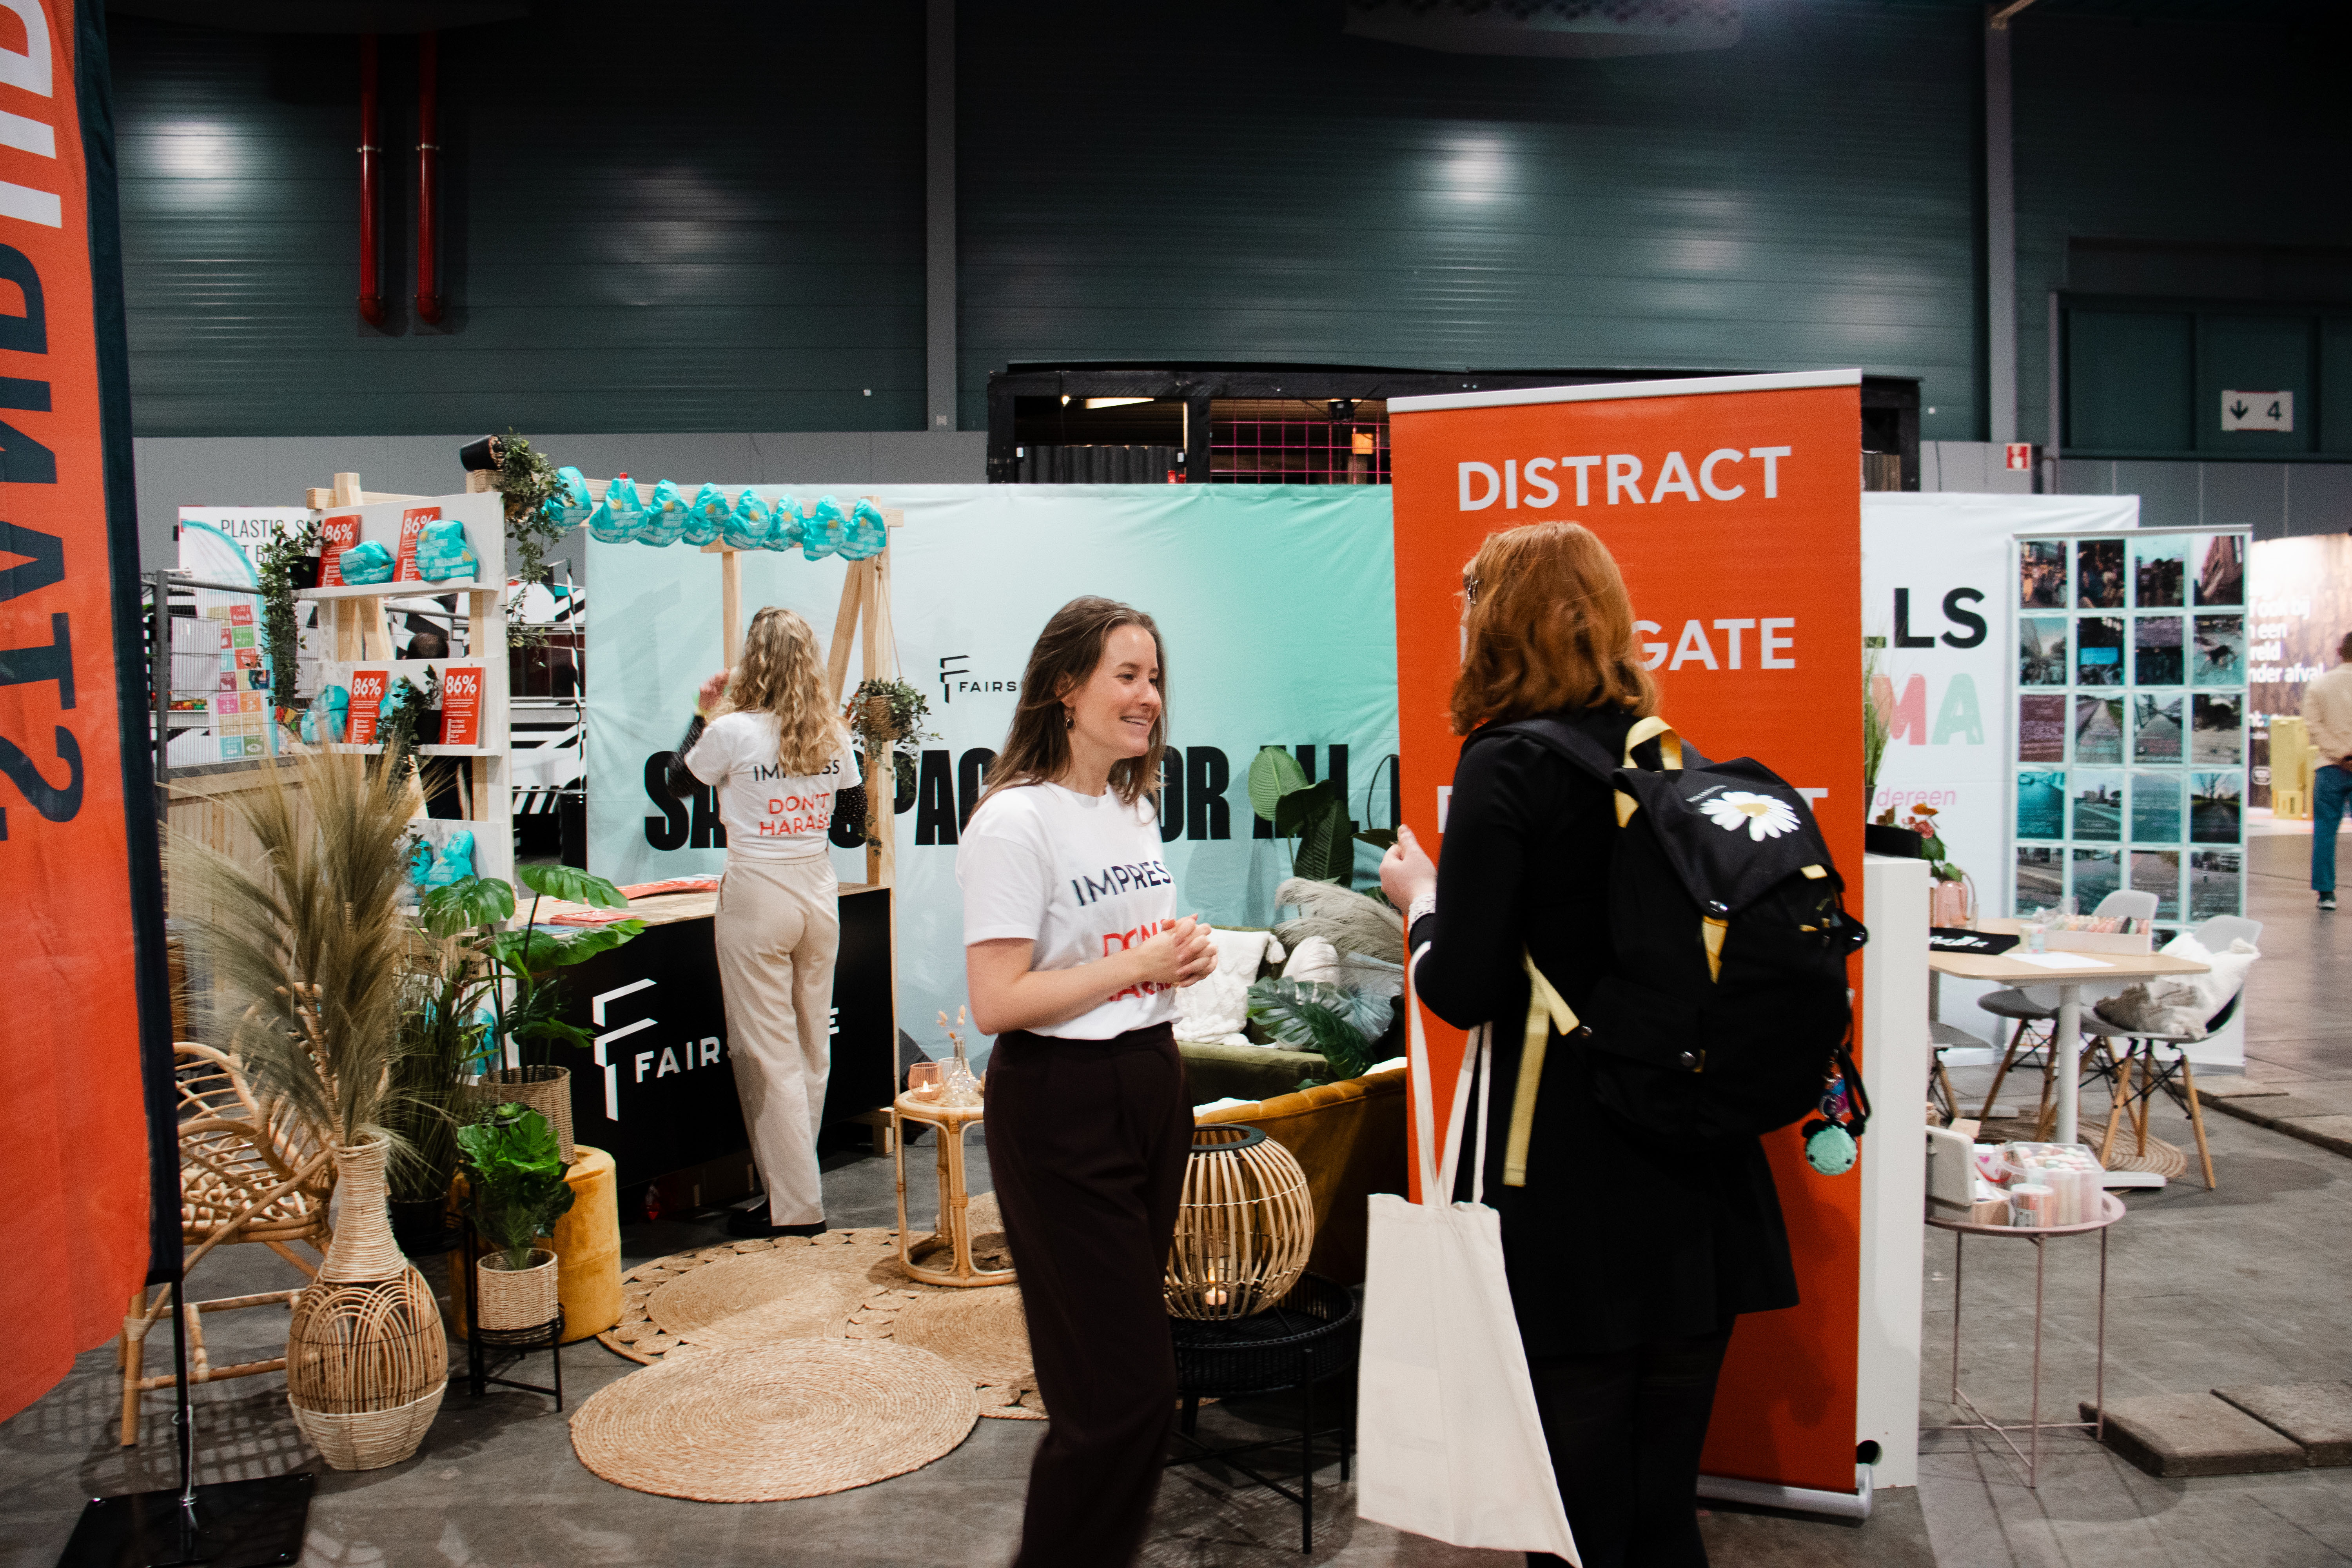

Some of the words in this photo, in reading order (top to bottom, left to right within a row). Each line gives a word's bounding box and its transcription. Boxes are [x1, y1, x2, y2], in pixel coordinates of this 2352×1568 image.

[2267, 401, 2282, 421] 4
[1458, 446, 1791, 511] DISTRACT
[325, 524, 353, 541] 86%
[1864, 587, 1988, 649] LS
[353, 678, 381, 695] 86%
[446, 675, 477, 694] 86%
[960, 682, 1016, 692] FAIRS
[753, 759, 840, 782] IMSS
[769, 793, 830, 815] DON'T
[1156, 745, 1231, 843] OR
[759, 811, 830, 836] HARASS
[1071, 860, 1175, 907] IMPRES
